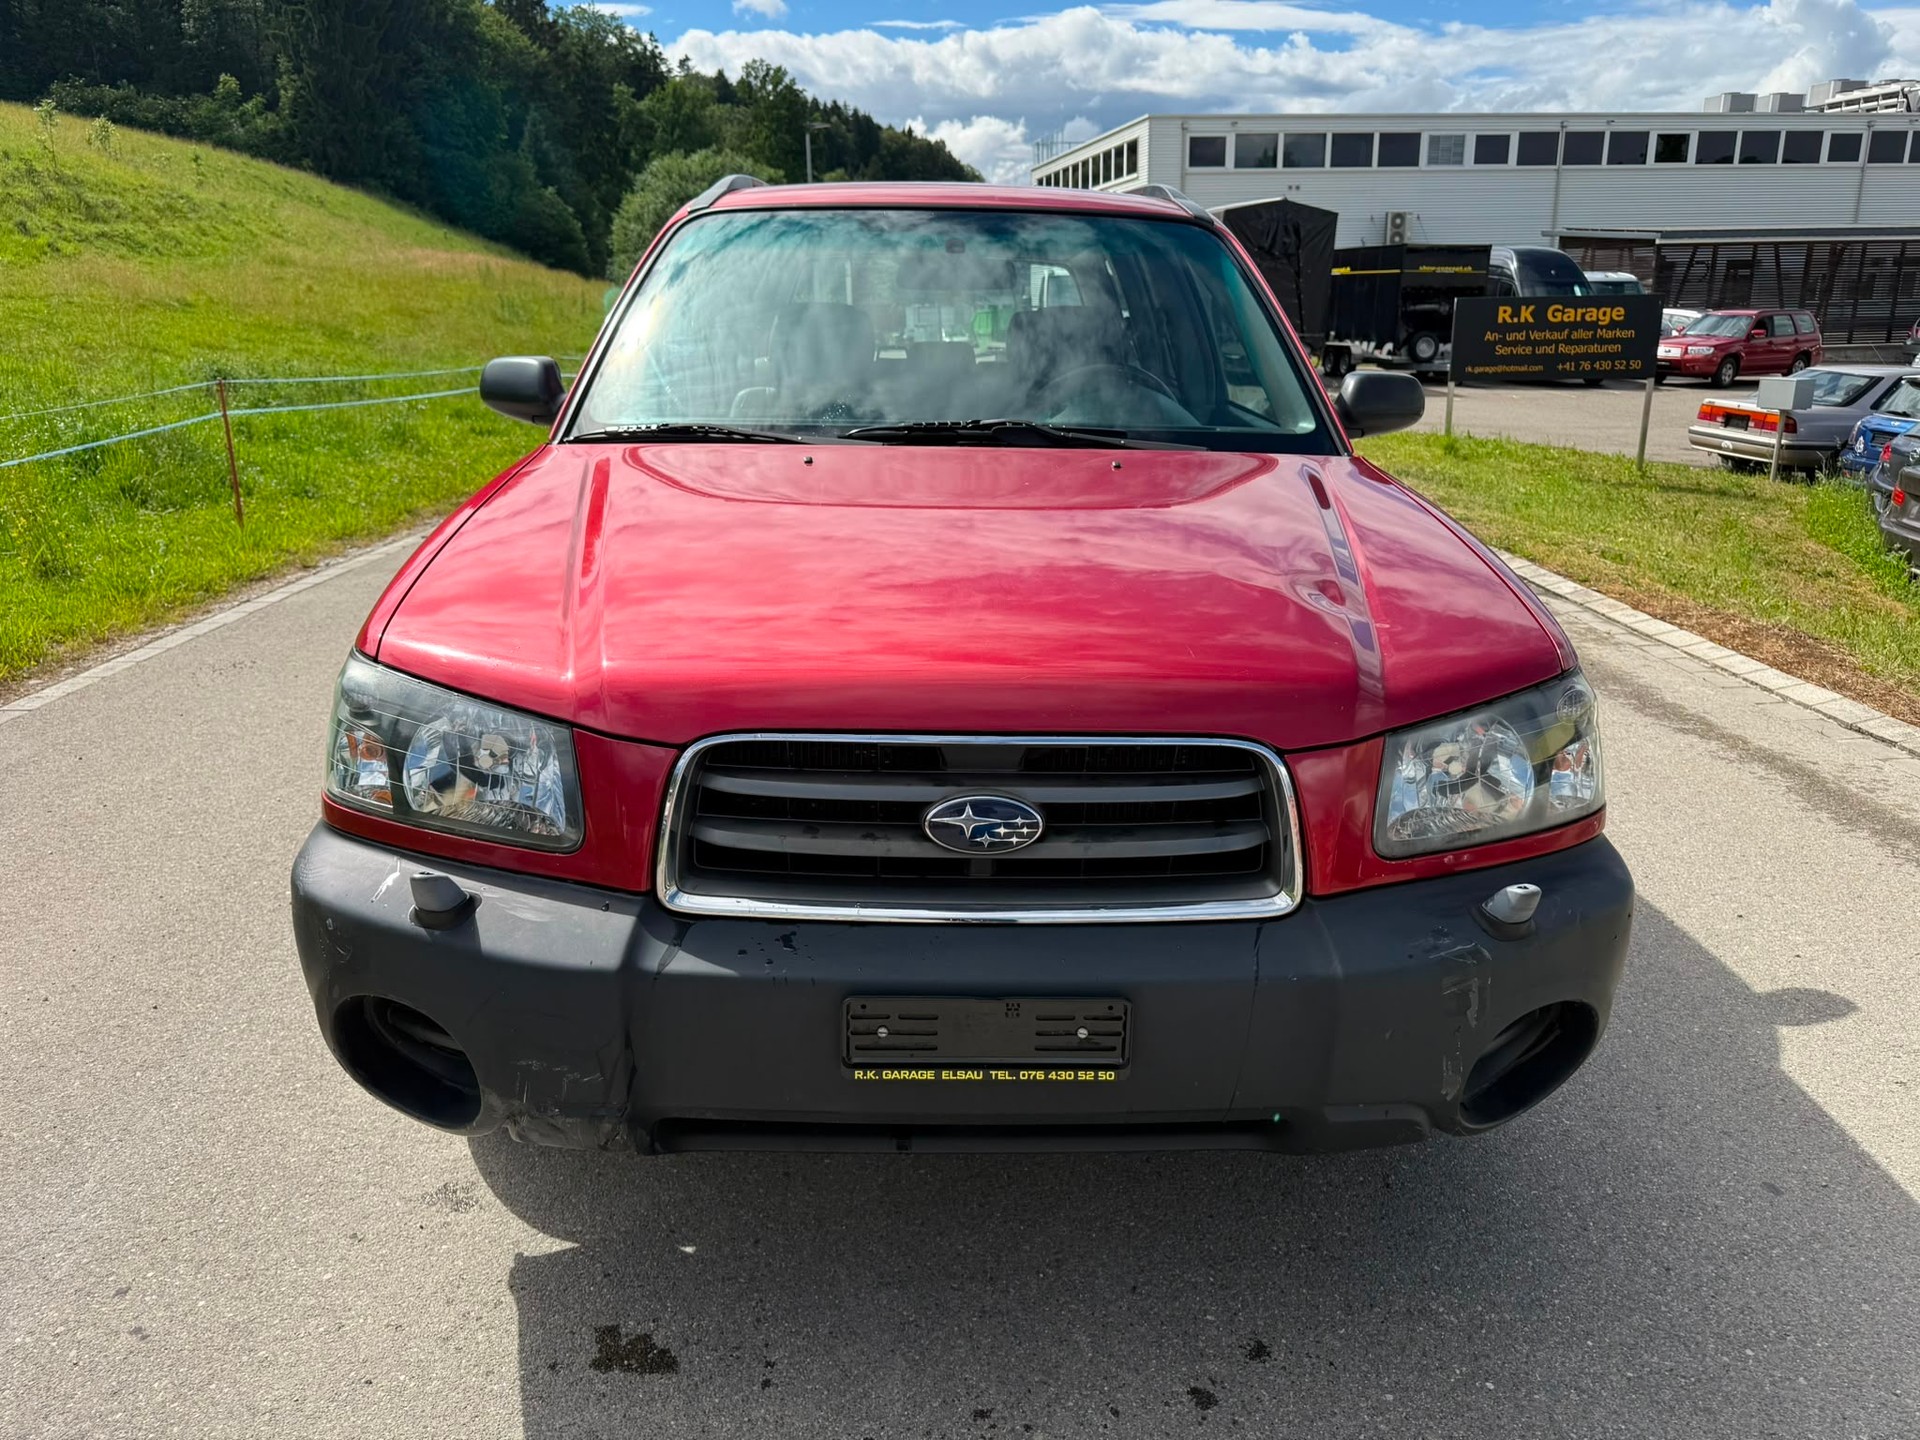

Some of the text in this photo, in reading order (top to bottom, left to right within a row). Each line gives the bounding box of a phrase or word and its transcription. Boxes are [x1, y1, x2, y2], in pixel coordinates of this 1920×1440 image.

[1497, 304, 1625, 325] R.K Garage
[1484, 328, 1635, 341] An- und Verkauf aller Marken
[1495, 343, 1621, 356] Service und Reparaturen
[1465, 364, 1543, 374] rk.garage@hotmail.com
[1557, 360, 1641, 371] +41 76 430 52 50
[854, 1070, 1115, 1080] R.K. GARAGE ELSAU TEL. 076 430 52 50
